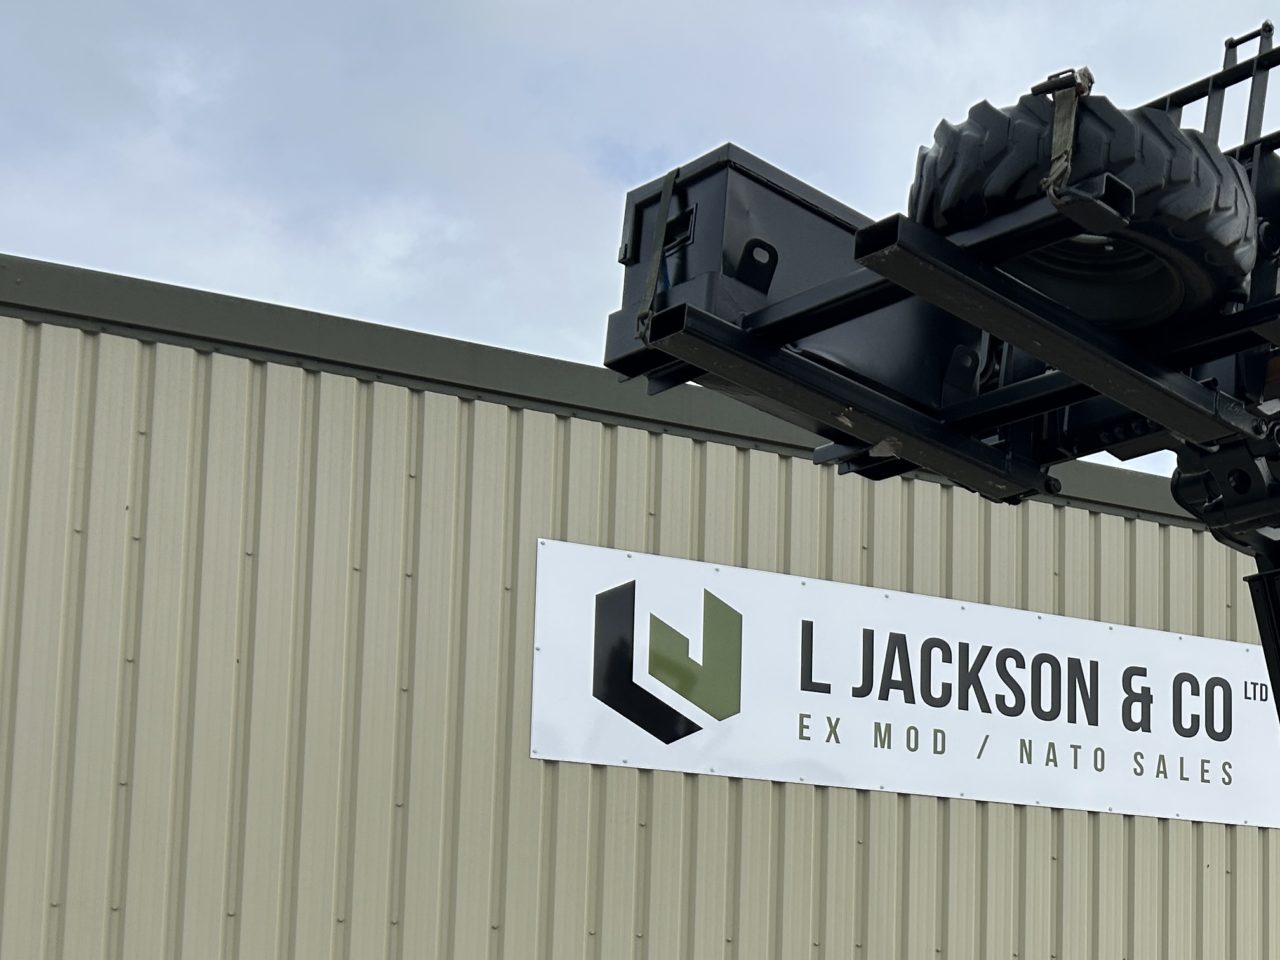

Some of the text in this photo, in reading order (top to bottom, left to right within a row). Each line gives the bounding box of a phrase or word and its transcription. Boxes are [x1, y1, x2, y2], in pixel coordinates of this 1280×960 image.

[800, 619, 1233, 743] L JACKSON & CO
[1243, 680, 1269, 702] LTD
[798, 713, 1233, 786] EX MOD / NATO SALES
